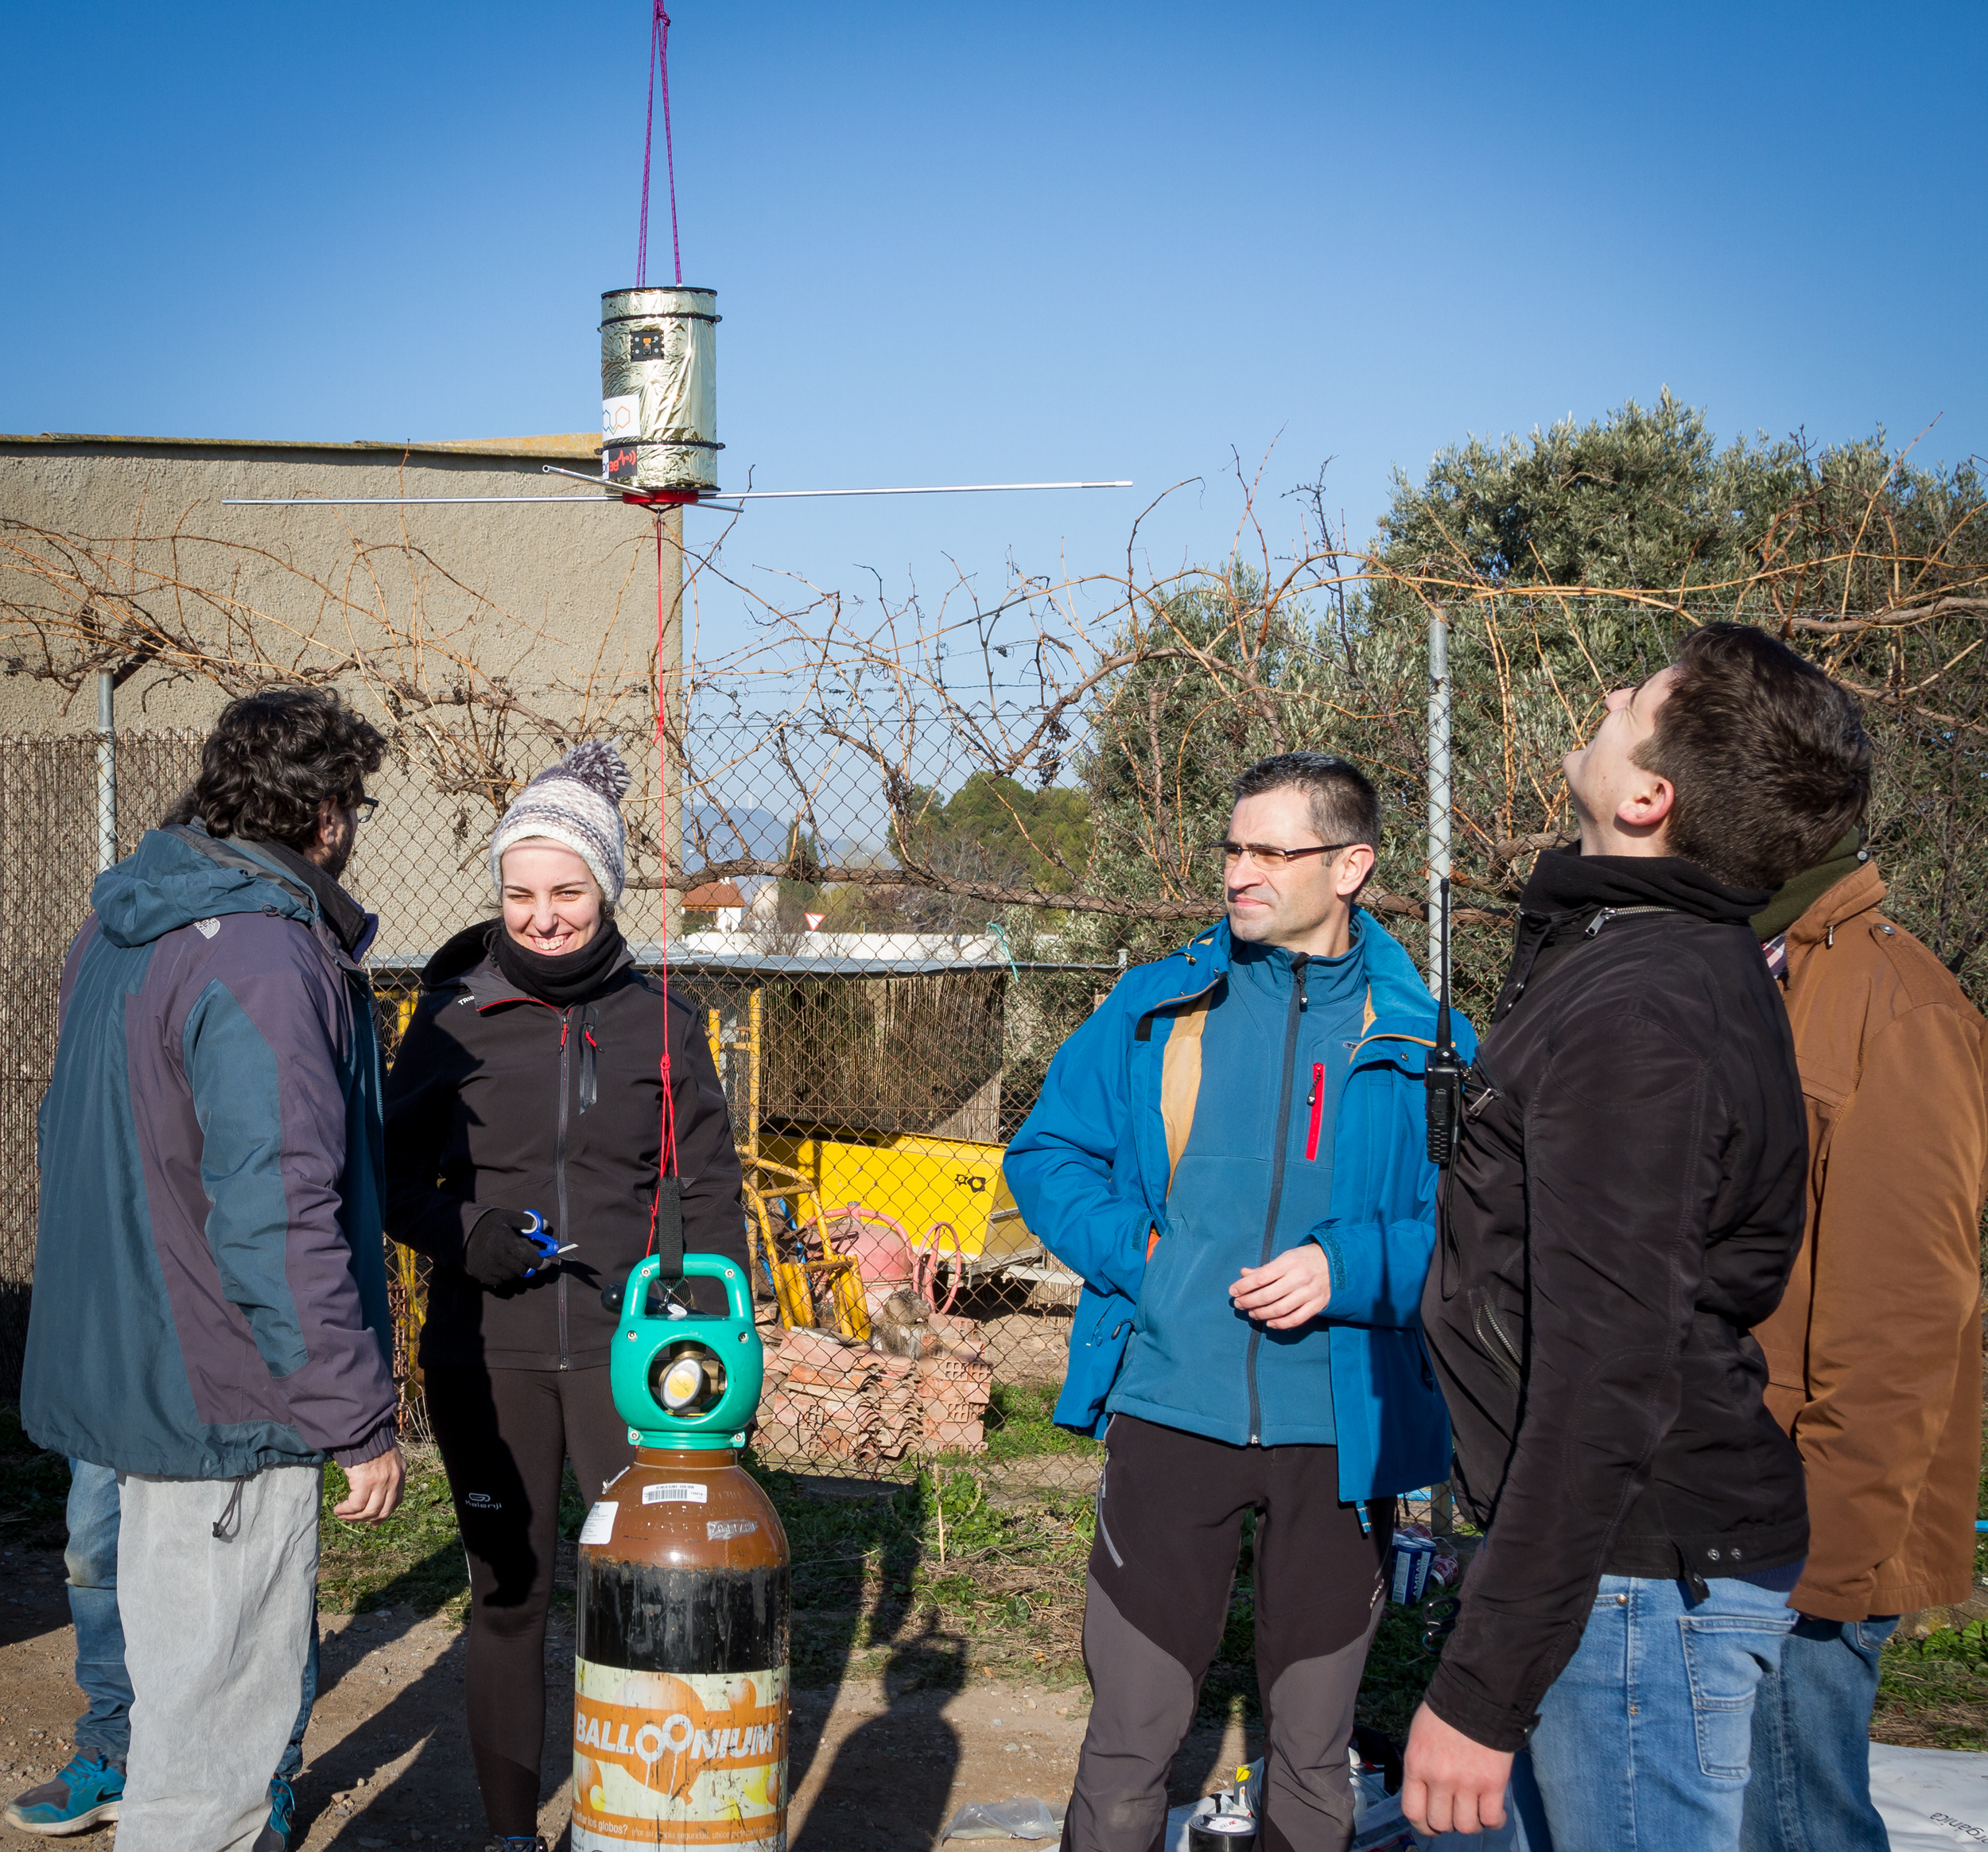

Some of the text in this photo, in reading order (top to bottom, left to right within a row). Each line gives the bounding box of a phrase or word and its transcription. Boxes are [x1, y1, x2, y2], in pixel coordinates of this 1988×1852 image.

[457, 995, 475, 1006] TRIB
[464, 1499, 502, 1510] Kalenji
[575, 1712, 775, 1762] BALLOONIUM
[588, 1816, 597, 1828] los
[598, 1820, 628, 1835] globos?
